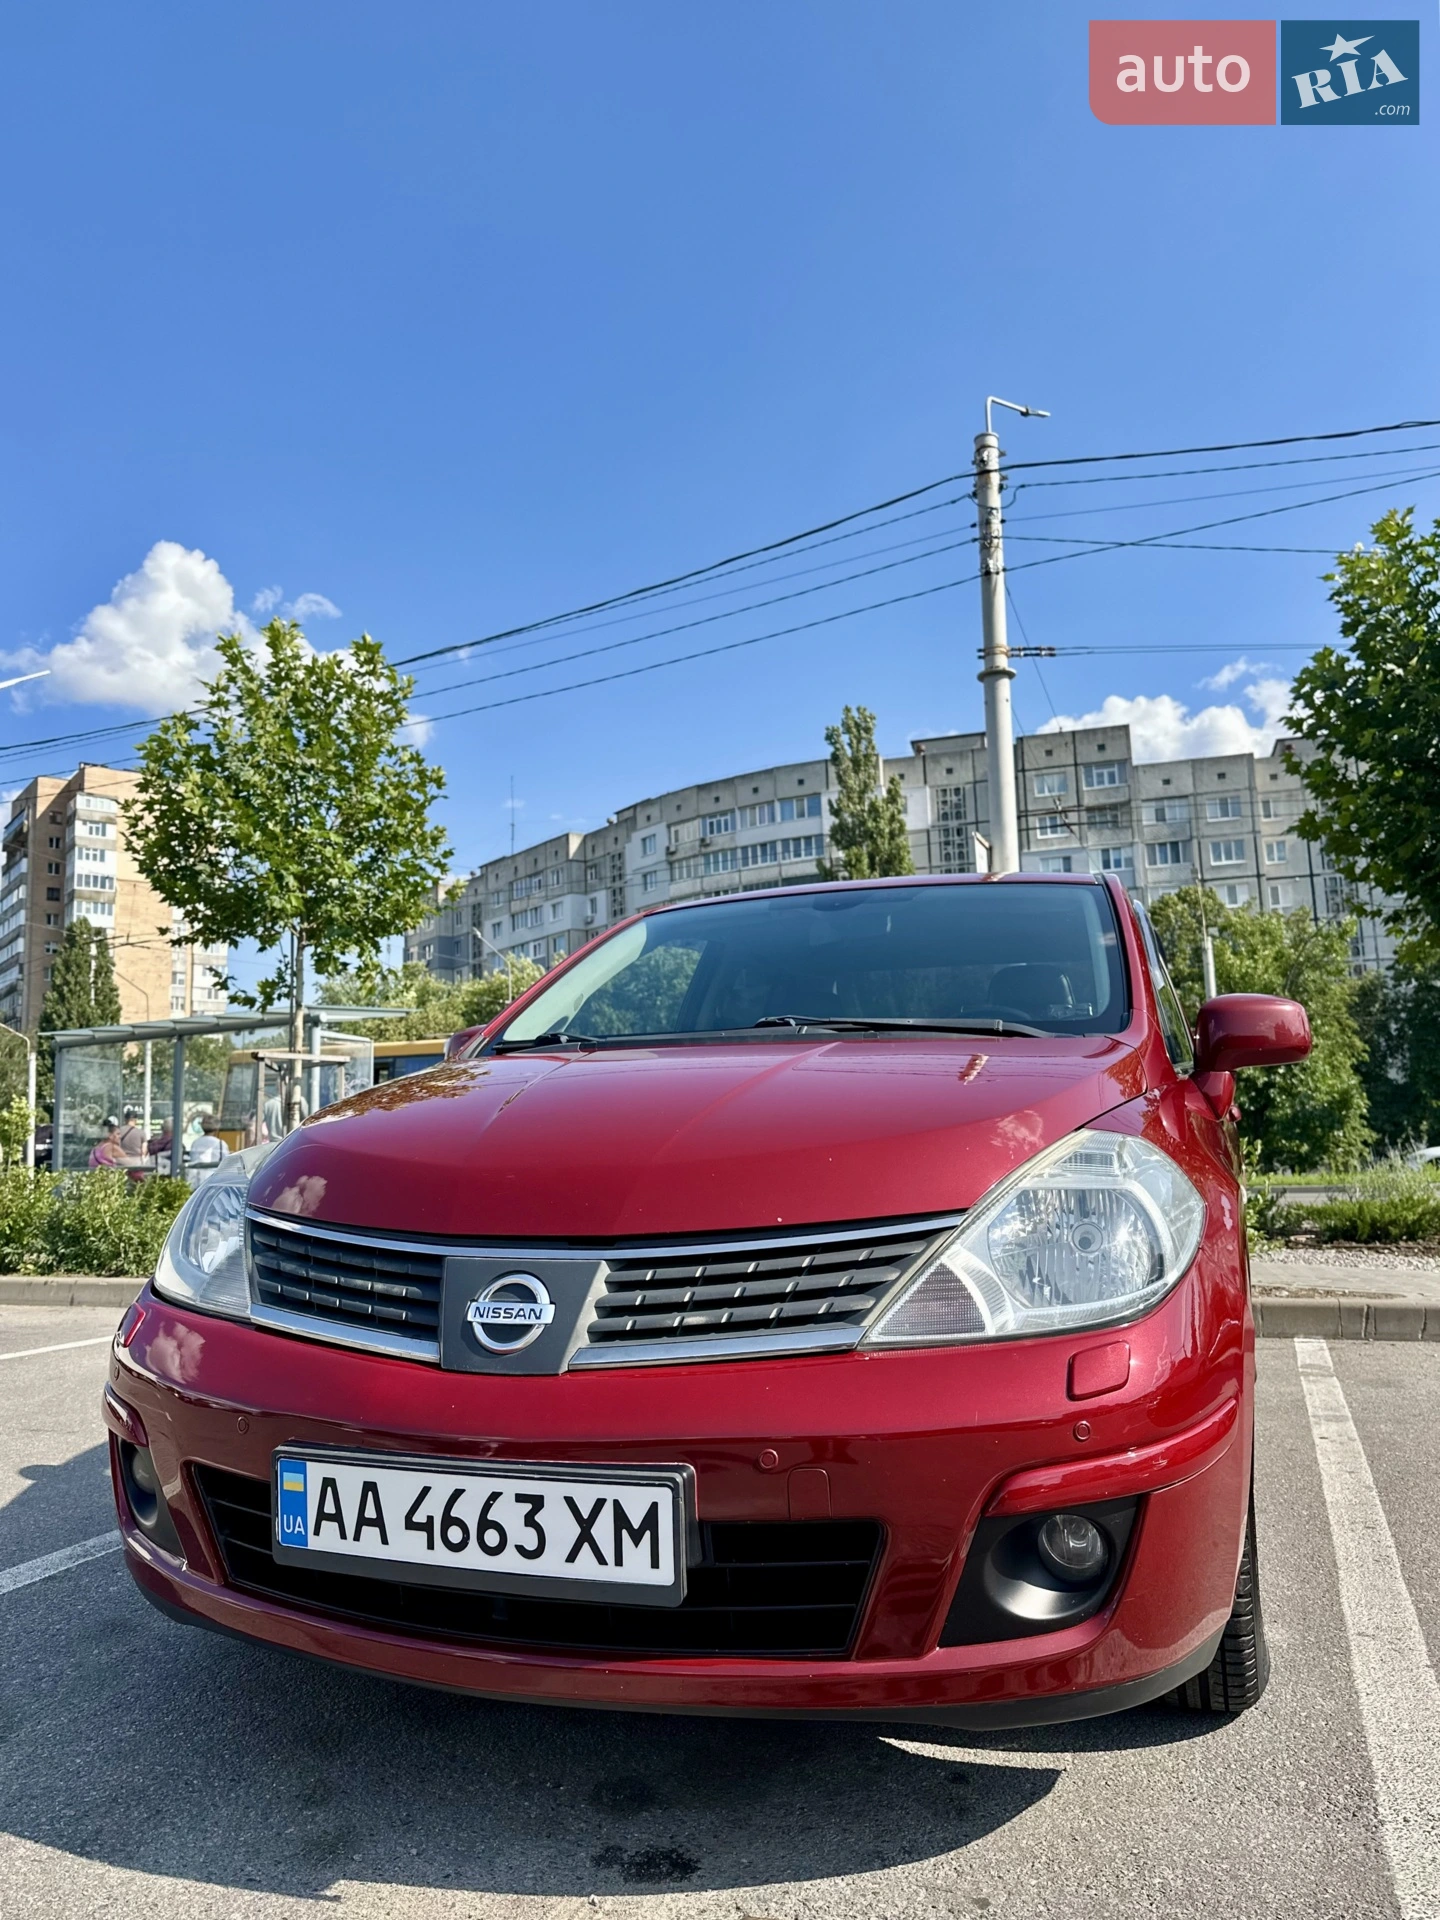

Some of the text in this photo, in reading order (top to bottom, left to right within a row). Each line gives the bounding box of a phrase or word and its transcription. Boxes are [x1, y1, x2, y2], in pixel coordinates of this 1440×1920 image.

[473, 1306, 543, 1320] NISSAN
[283, 1514, 306, 1536] UA
[312, 1476, 660, 1570] AA 4663 XM
